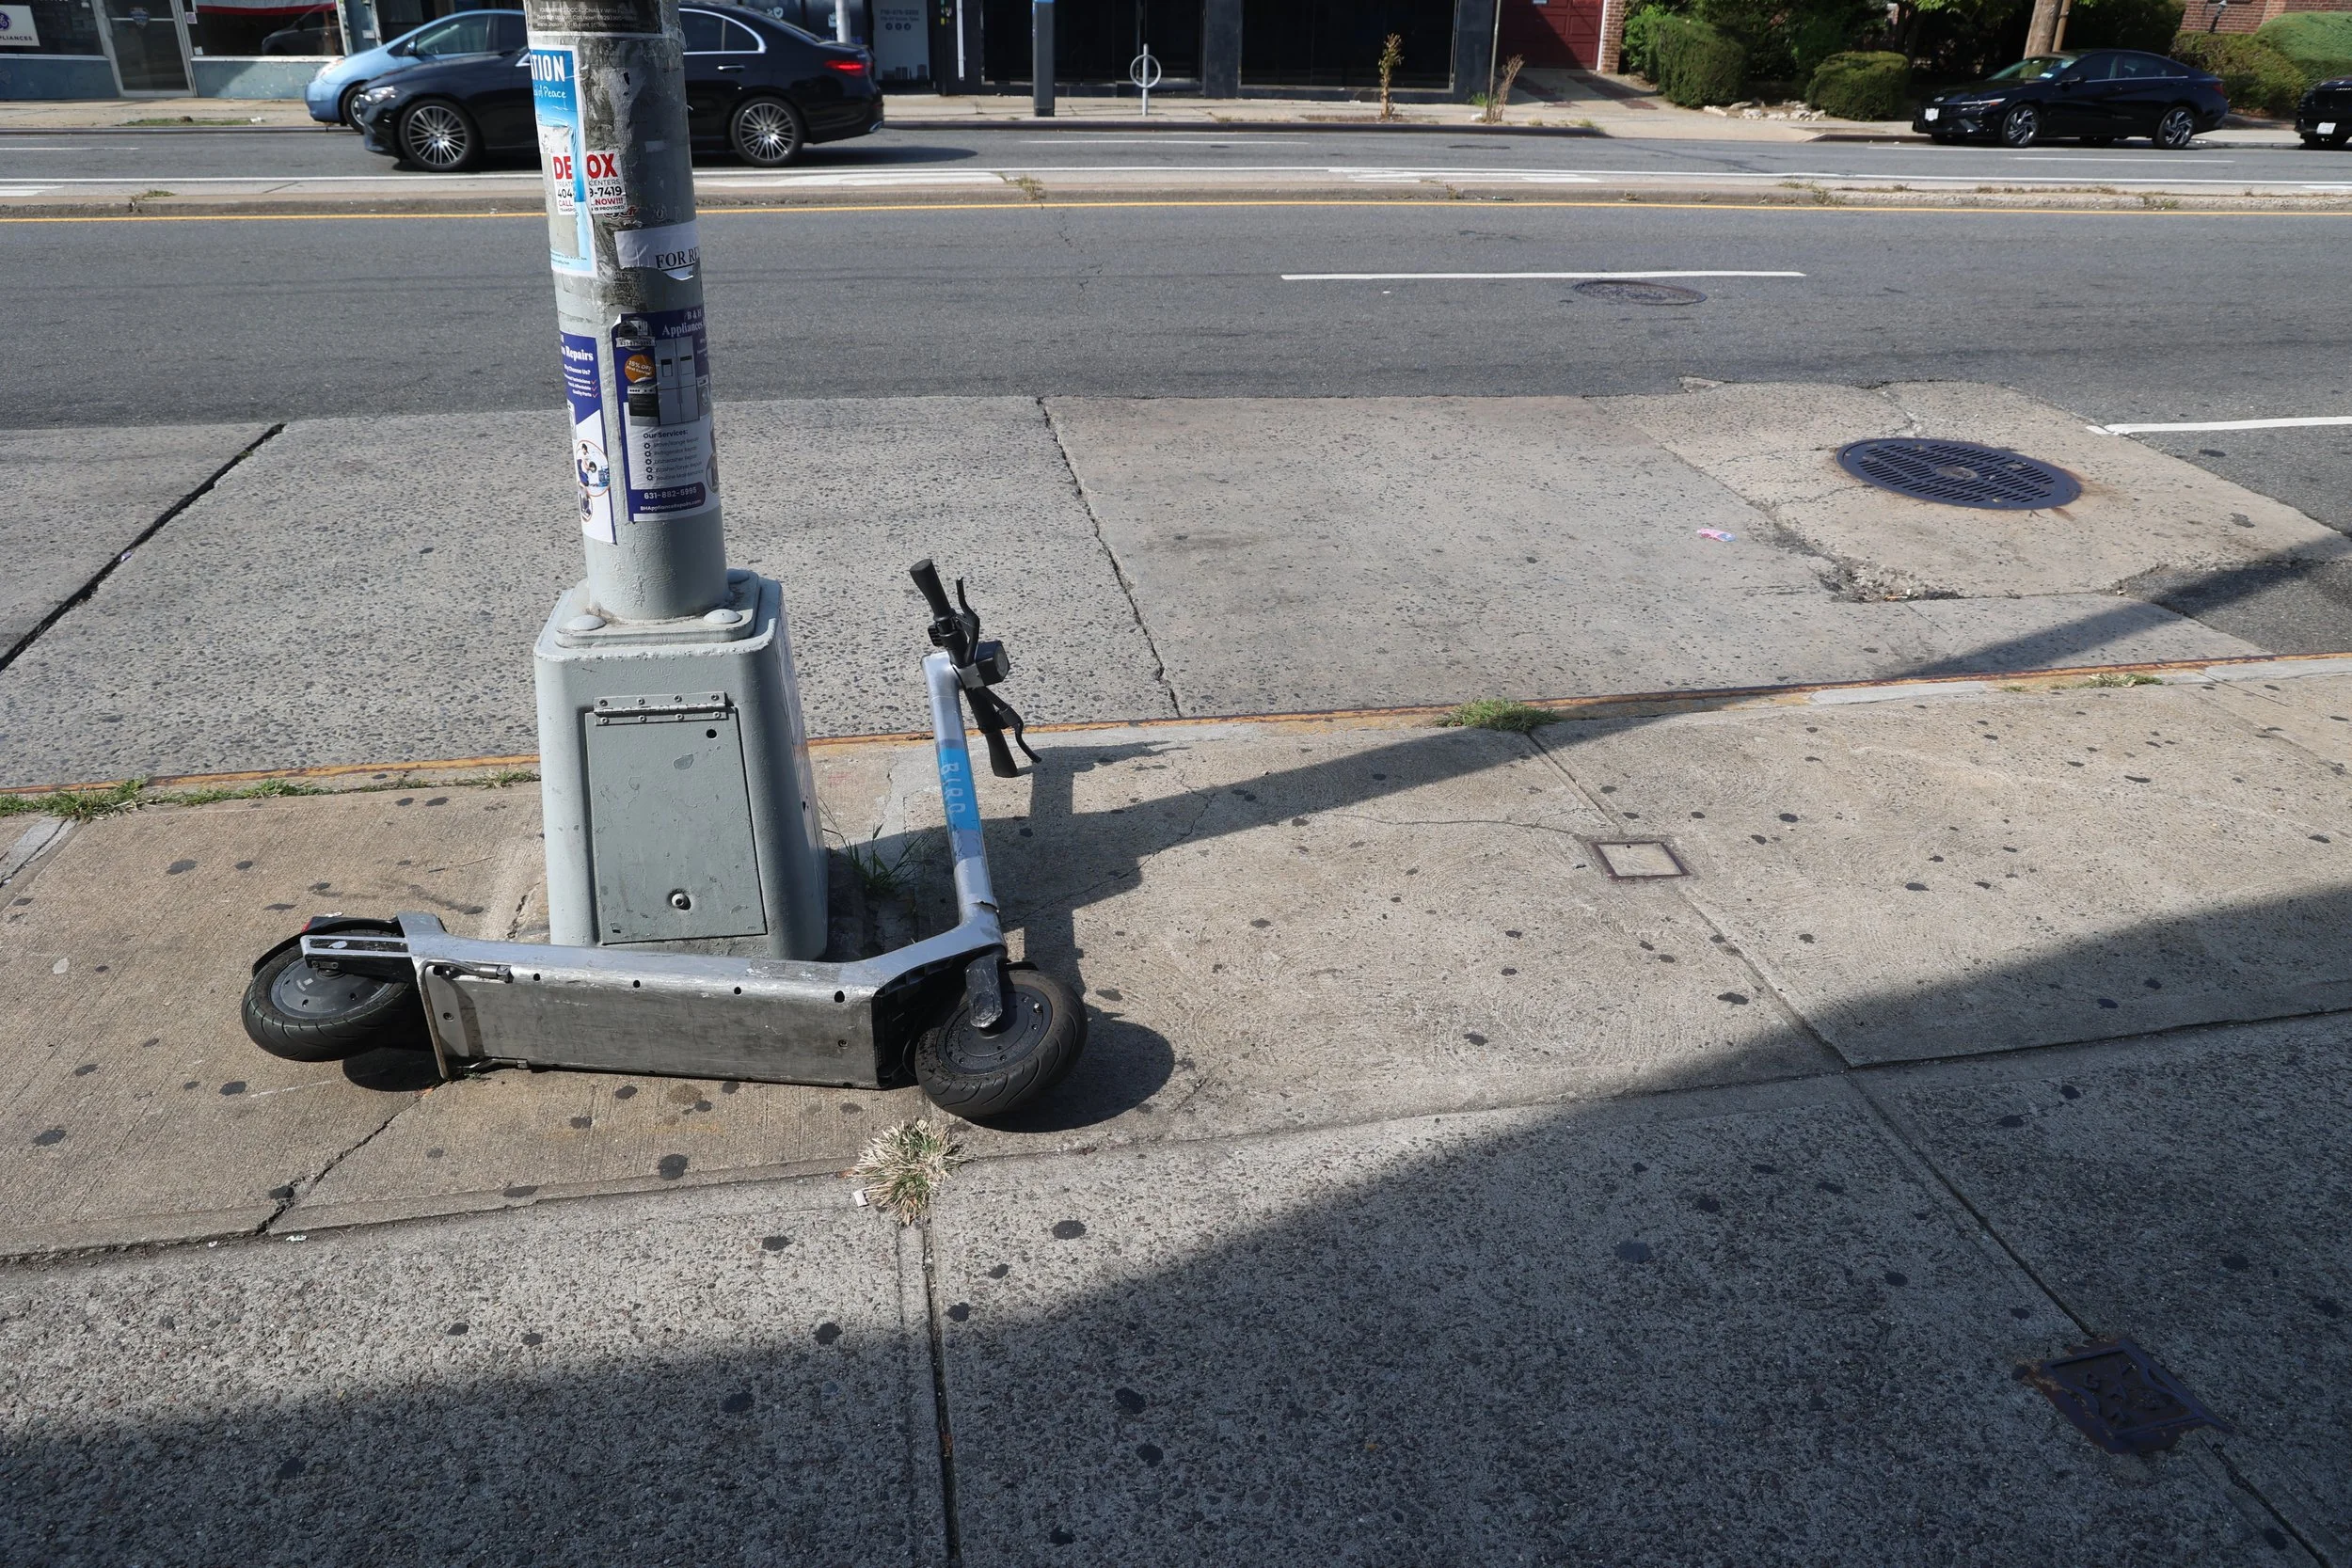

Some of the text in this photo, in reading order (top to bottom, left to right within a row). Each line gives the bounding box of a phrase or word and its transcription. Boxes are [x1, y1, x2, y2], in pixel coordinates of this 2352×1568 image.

[544, 86, 566, 99] Peace
[552, 153, 618, 180] DEOX
[588, 179, 621, 187] CENTERS
[595, 197, 624, 206] NOW!!!
[655, 250, 687, 268] FOR
[565, 345, 594, 362] Repairs
[658, 429, 688, 438] Services:
